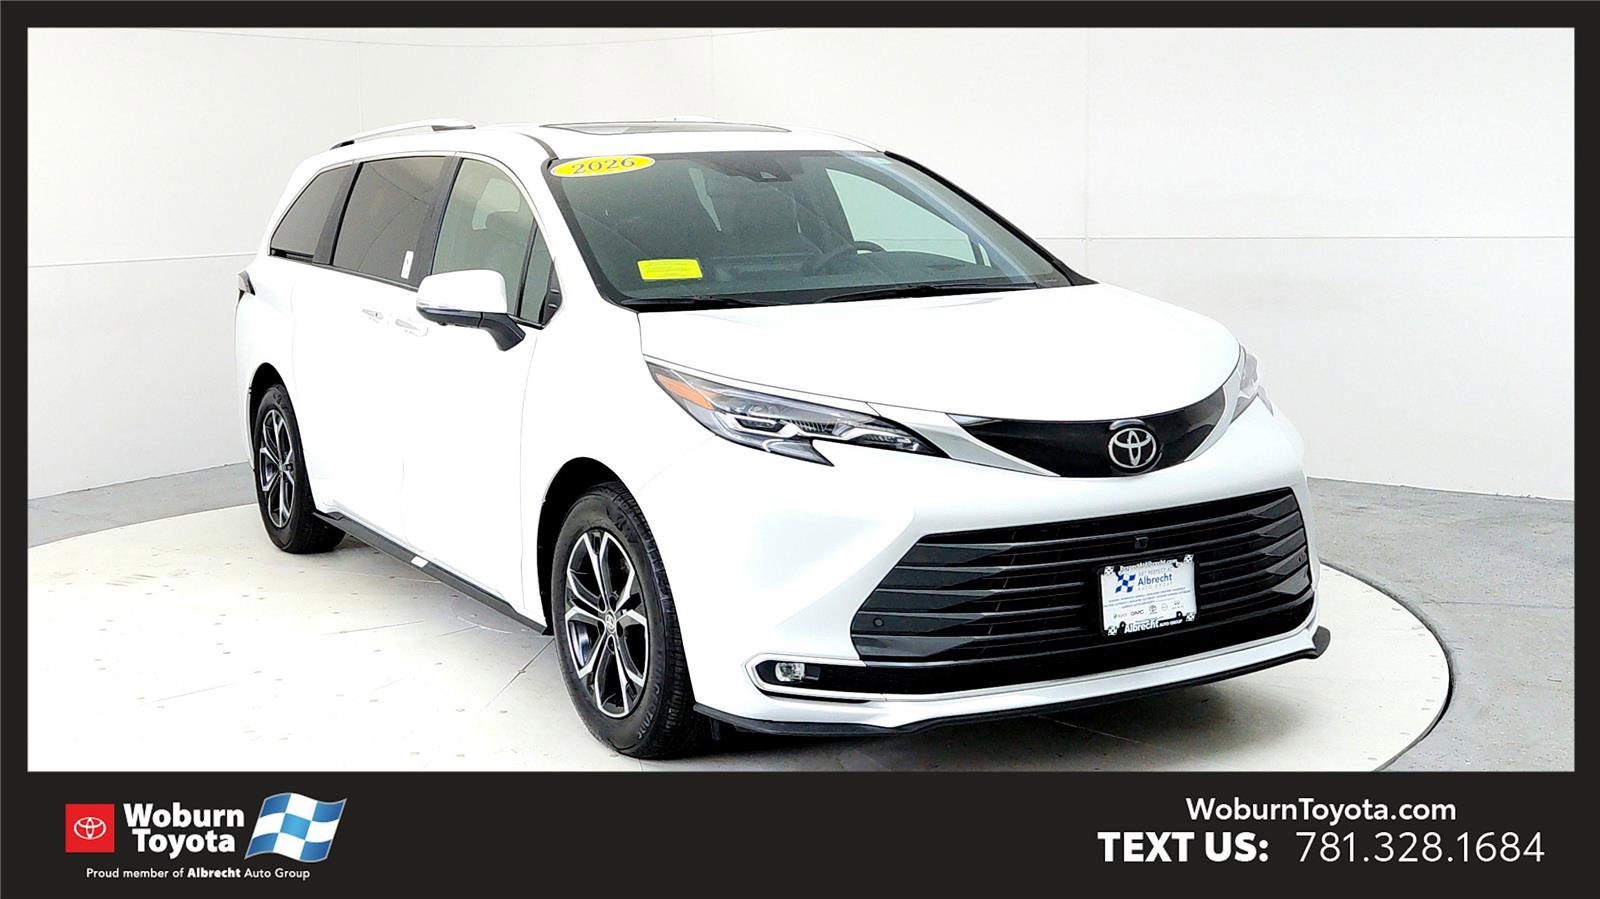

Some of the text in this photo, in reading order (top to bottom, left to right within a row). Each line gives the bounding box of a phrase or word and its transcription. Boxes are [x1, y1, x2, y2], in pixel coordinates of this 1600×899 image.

[572, 157, 636, 175] 2026
[1137, 573, 1173, 586] Albrecht
[1124, 619, 1158, 633] Albrecht
